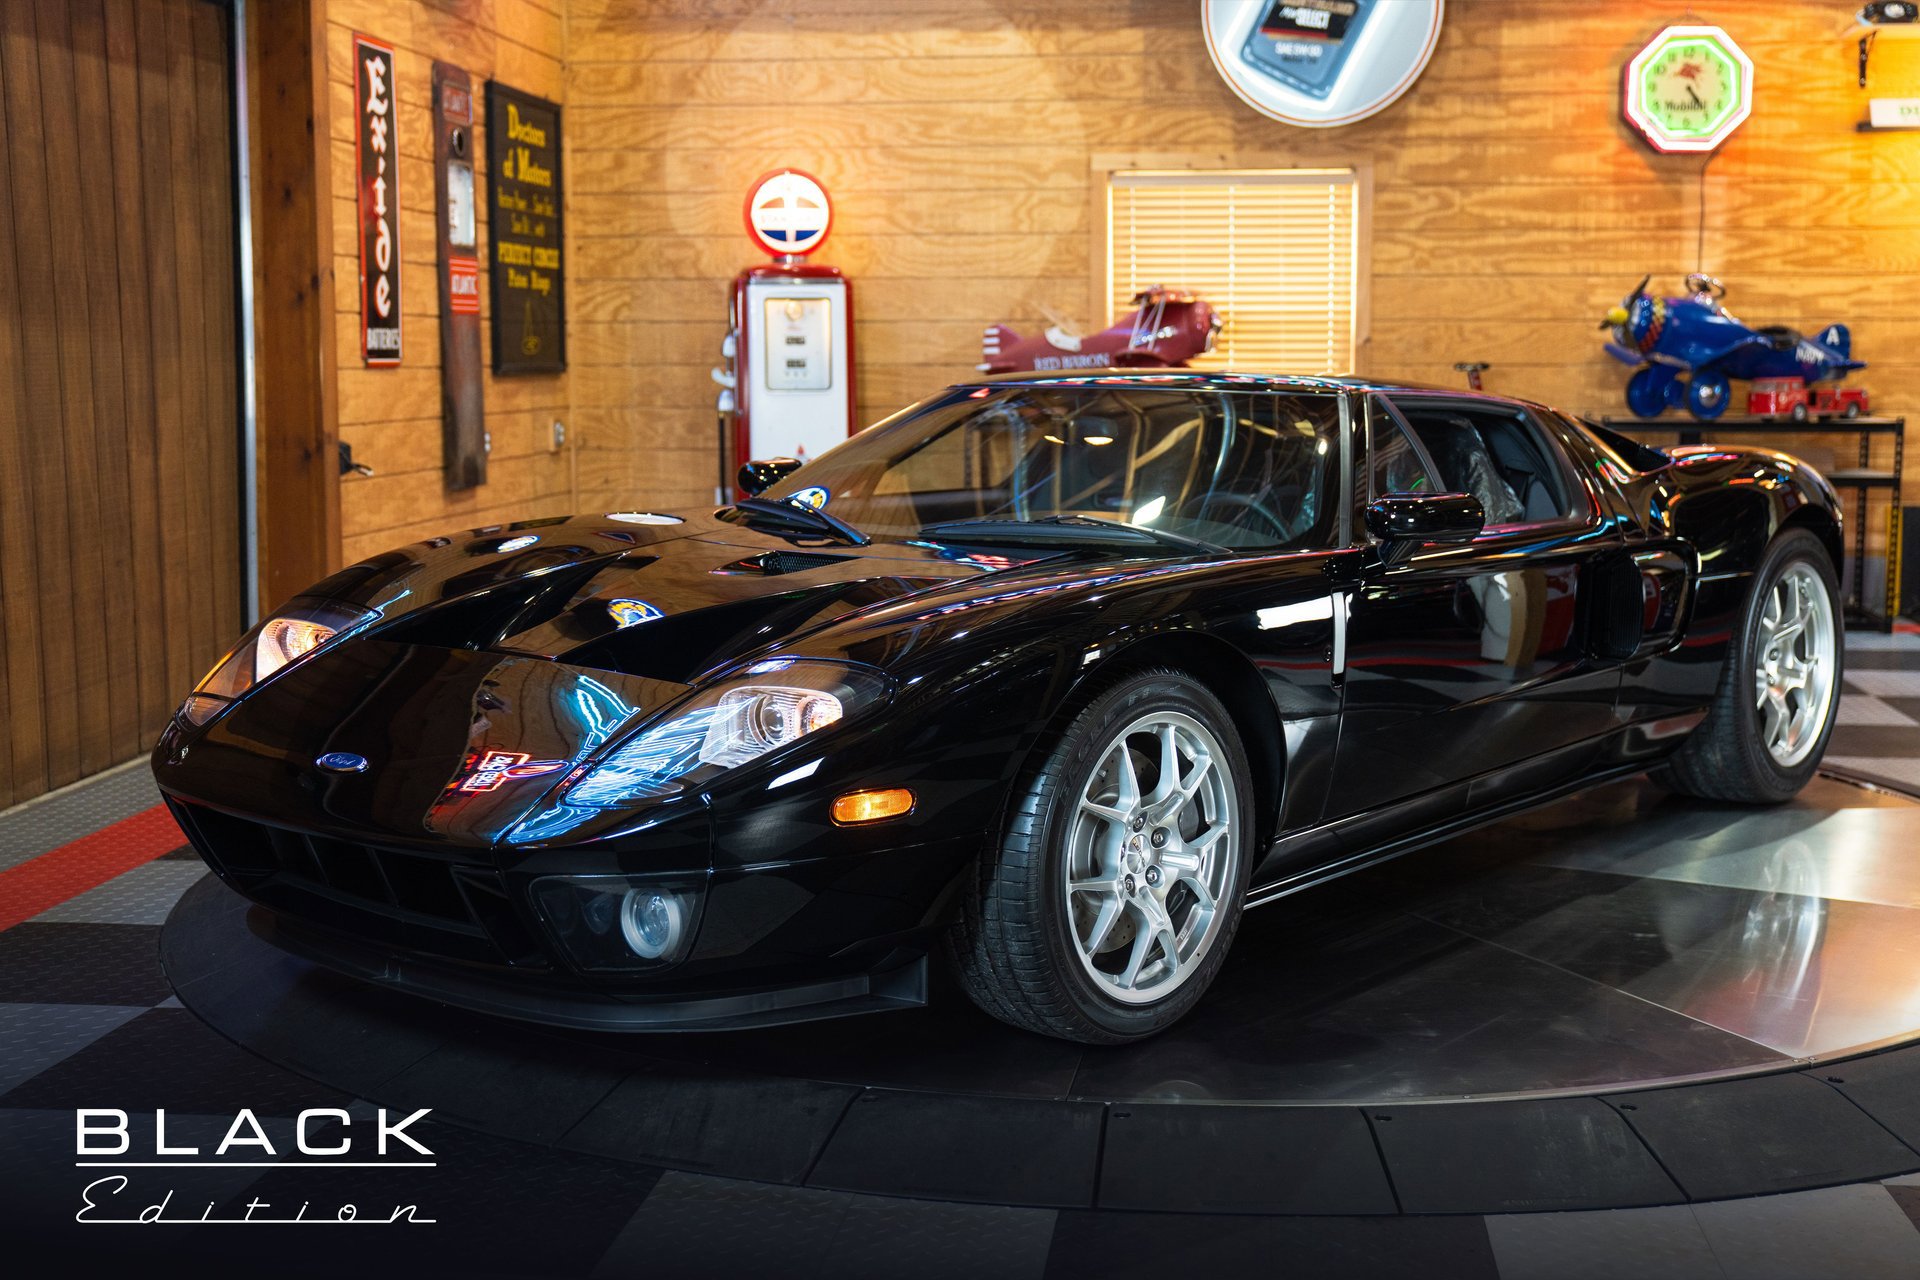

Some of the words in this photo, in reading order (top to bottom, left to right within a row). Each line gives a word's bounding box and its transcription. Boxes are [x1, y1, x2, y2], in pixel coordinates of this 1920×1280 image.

[507, 103, 545, 148] Doctors
[503, 149, 513, 178] of
[517, 147, 551, 187] Motors
[364, 55, 392, 318] Exide
[367, 328, 400, 350] BATTERIES
[1826, 326, 1840, 346] A
[1035, 356, 1060, 371] RED
[1061, 353, 1110, 369] BARON
[1795, 344, 1825, 366] NAVY
